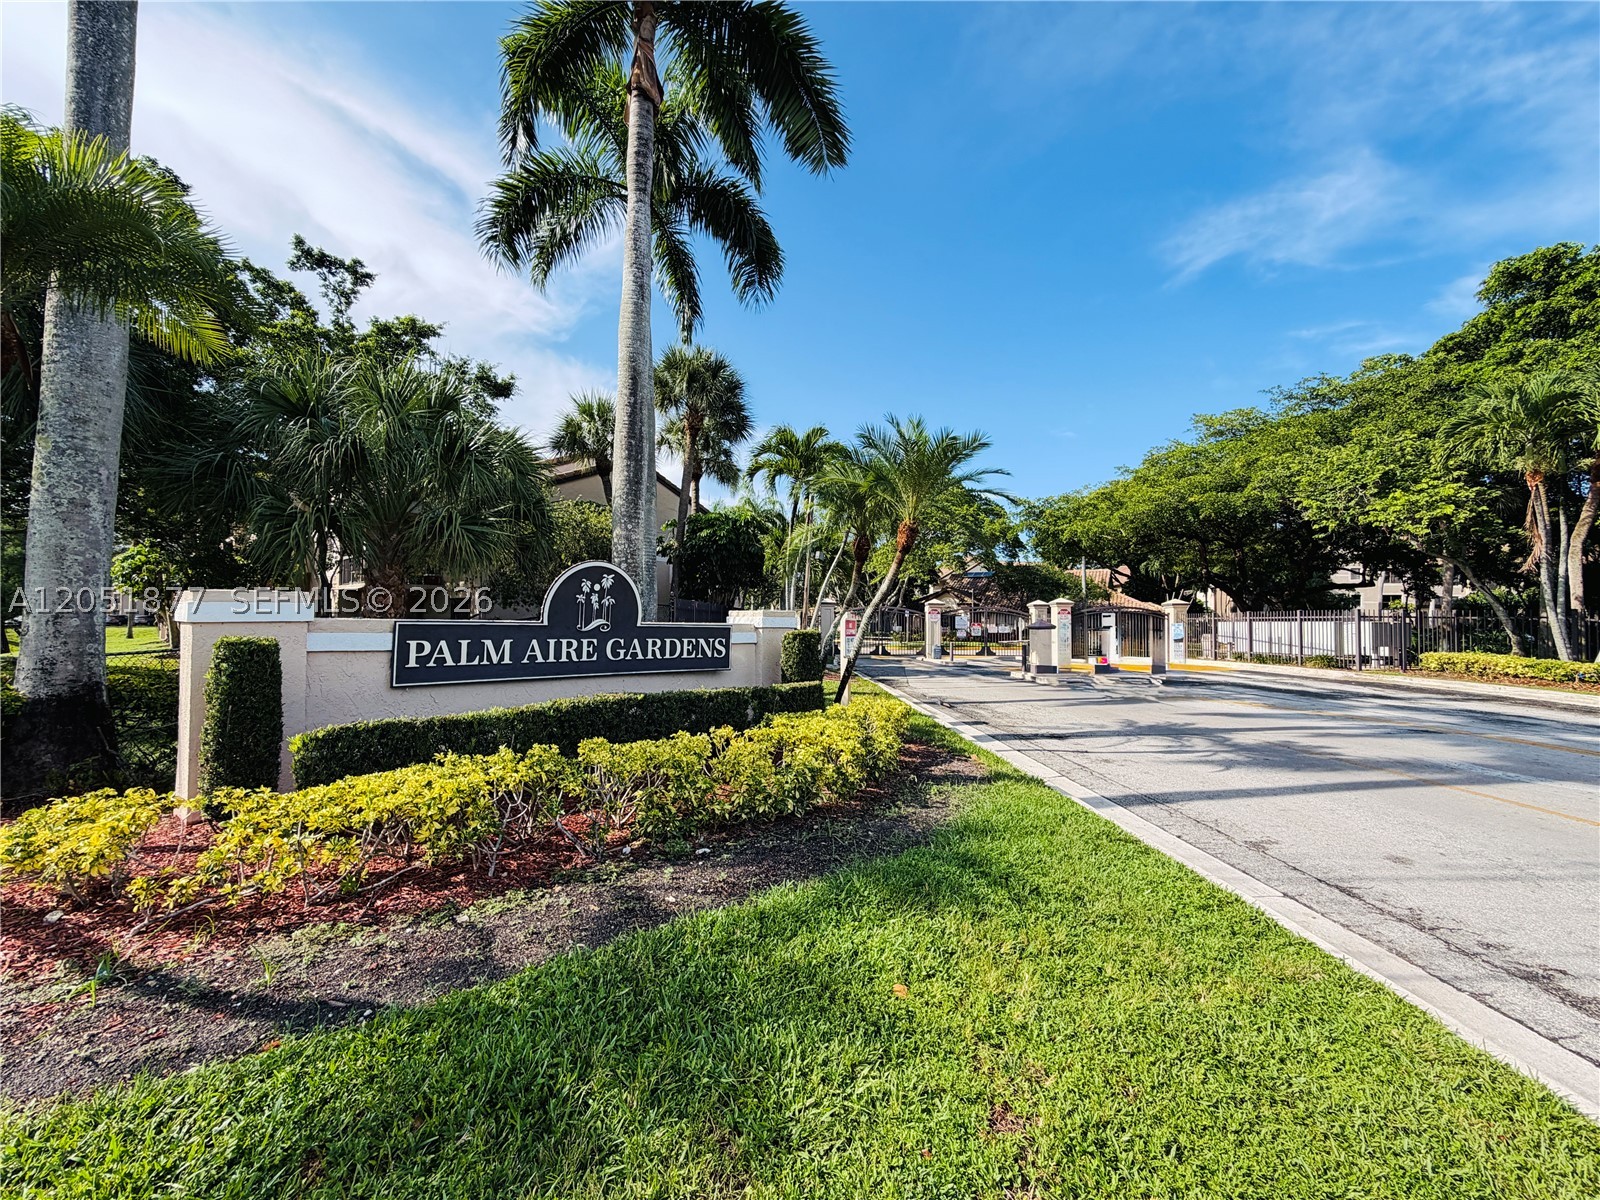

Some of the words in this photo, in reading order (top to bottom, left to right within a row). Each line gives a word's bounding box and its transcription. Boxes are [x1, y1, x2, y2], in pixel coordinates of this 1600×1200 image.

[404, 638, 513, 668] PALM
[521, 636, 597, 663] AIRE
[605, 637, 727, 660] GARDENS
